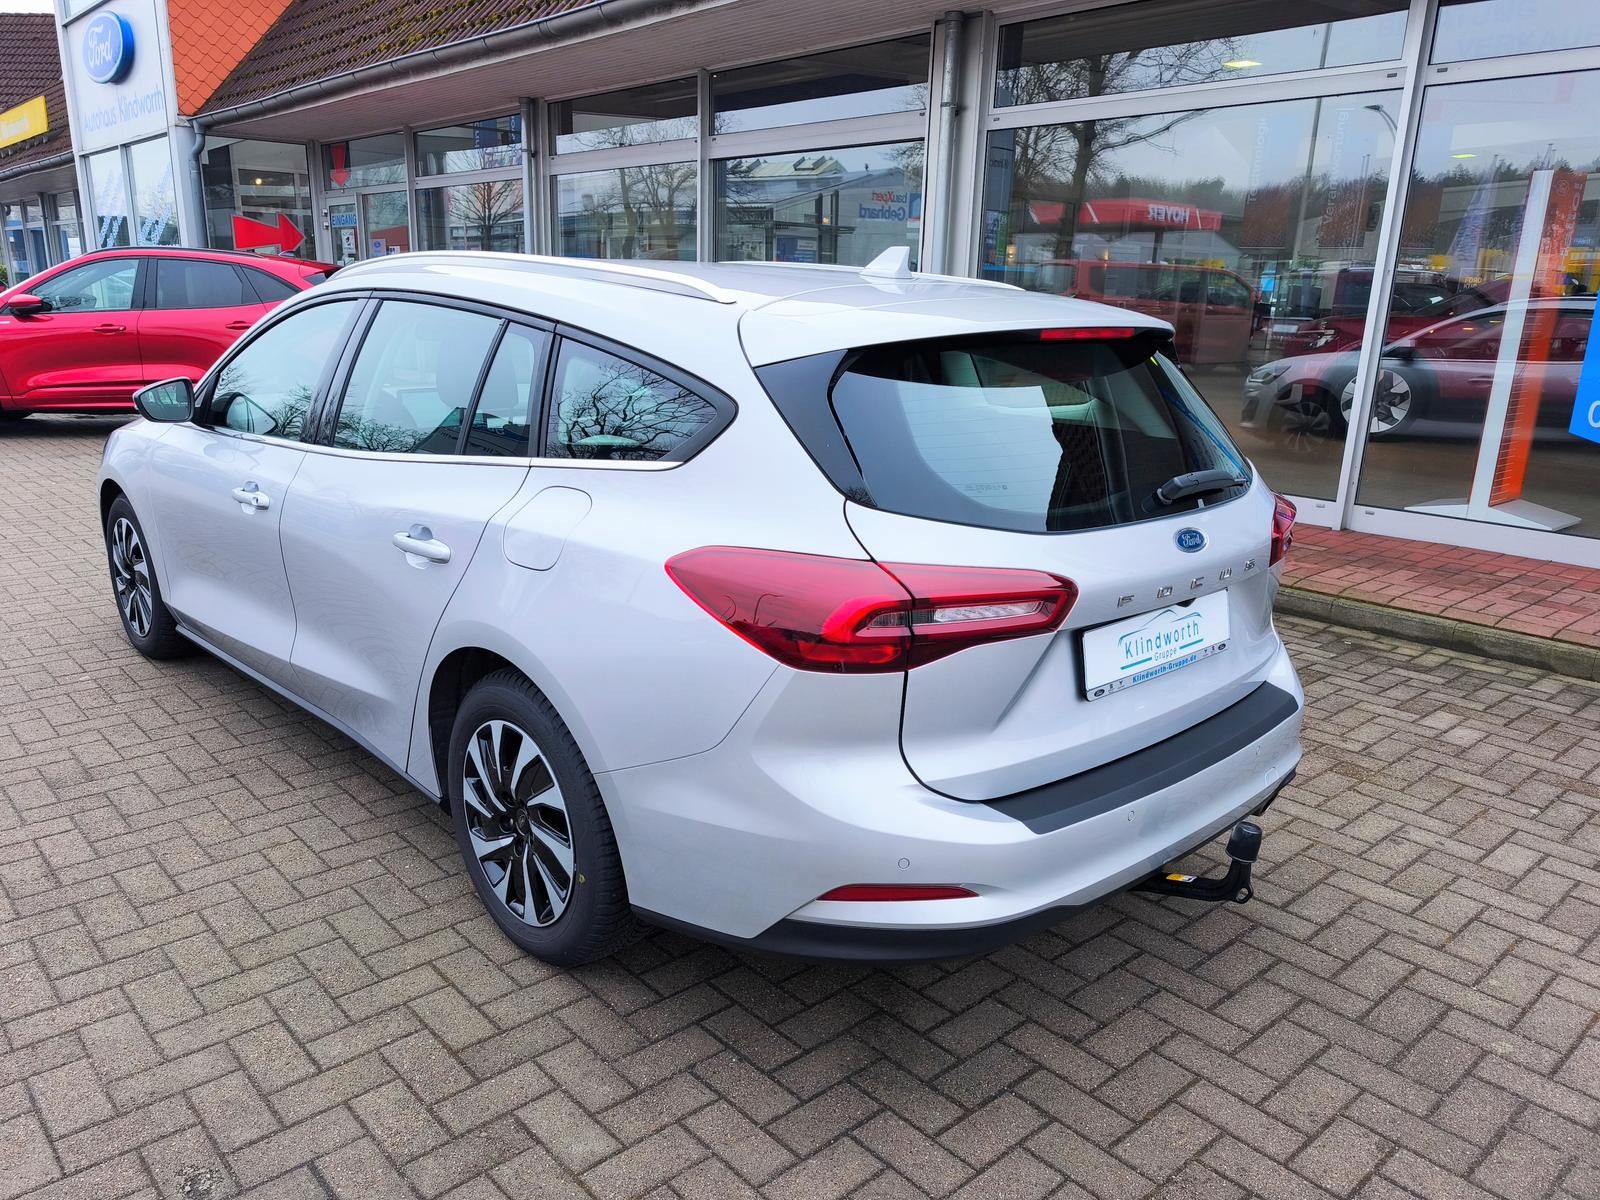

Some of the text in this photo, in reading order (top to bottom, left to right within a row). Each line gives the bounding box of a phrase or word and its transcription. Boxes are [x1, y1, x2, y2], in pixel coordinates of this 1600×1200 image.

[88, 24, 113, 69] Ford
[118, 83, 164, 122] Klindworth
[331, 214, 357, 226] EINGANG
[1116, 558, 1256, 608] FOCUS
[1125, 620, 1199, 659] Klindworth
[1154, 647, 1177, 661] Gruppe
[1132, 655, 1197, 683] Klindworth-Gruppe.de
